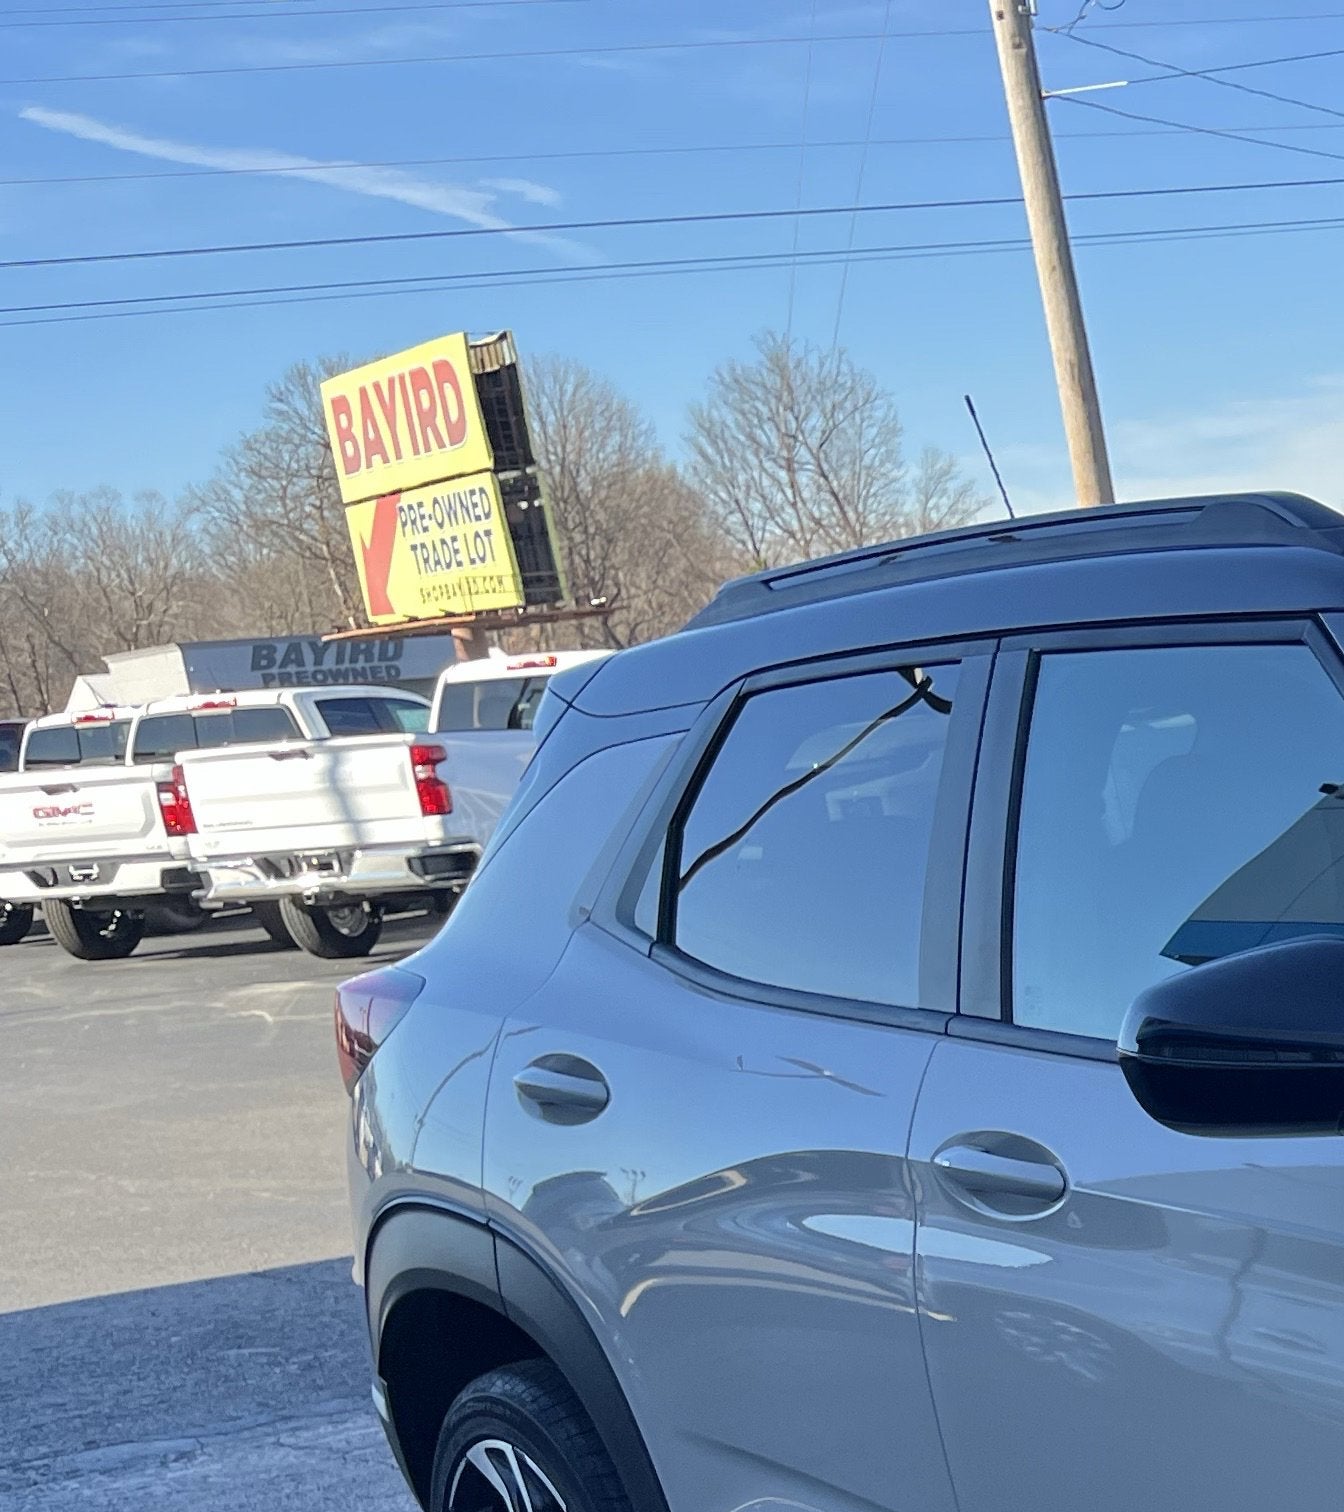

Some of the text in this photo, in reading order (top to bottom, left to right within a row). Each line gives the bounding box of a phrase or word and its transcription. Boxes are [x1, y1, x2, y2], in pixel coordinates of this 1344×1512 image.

[330, 359, 467, 476] BAYIRD
[398, 487, 492, 538] PRE-OWNED
[410, 529, 496, 575] TRADE LOT
[251, 639, 404, 672] BAYIRD
[261, 664, 402, 688] PREOWNED
